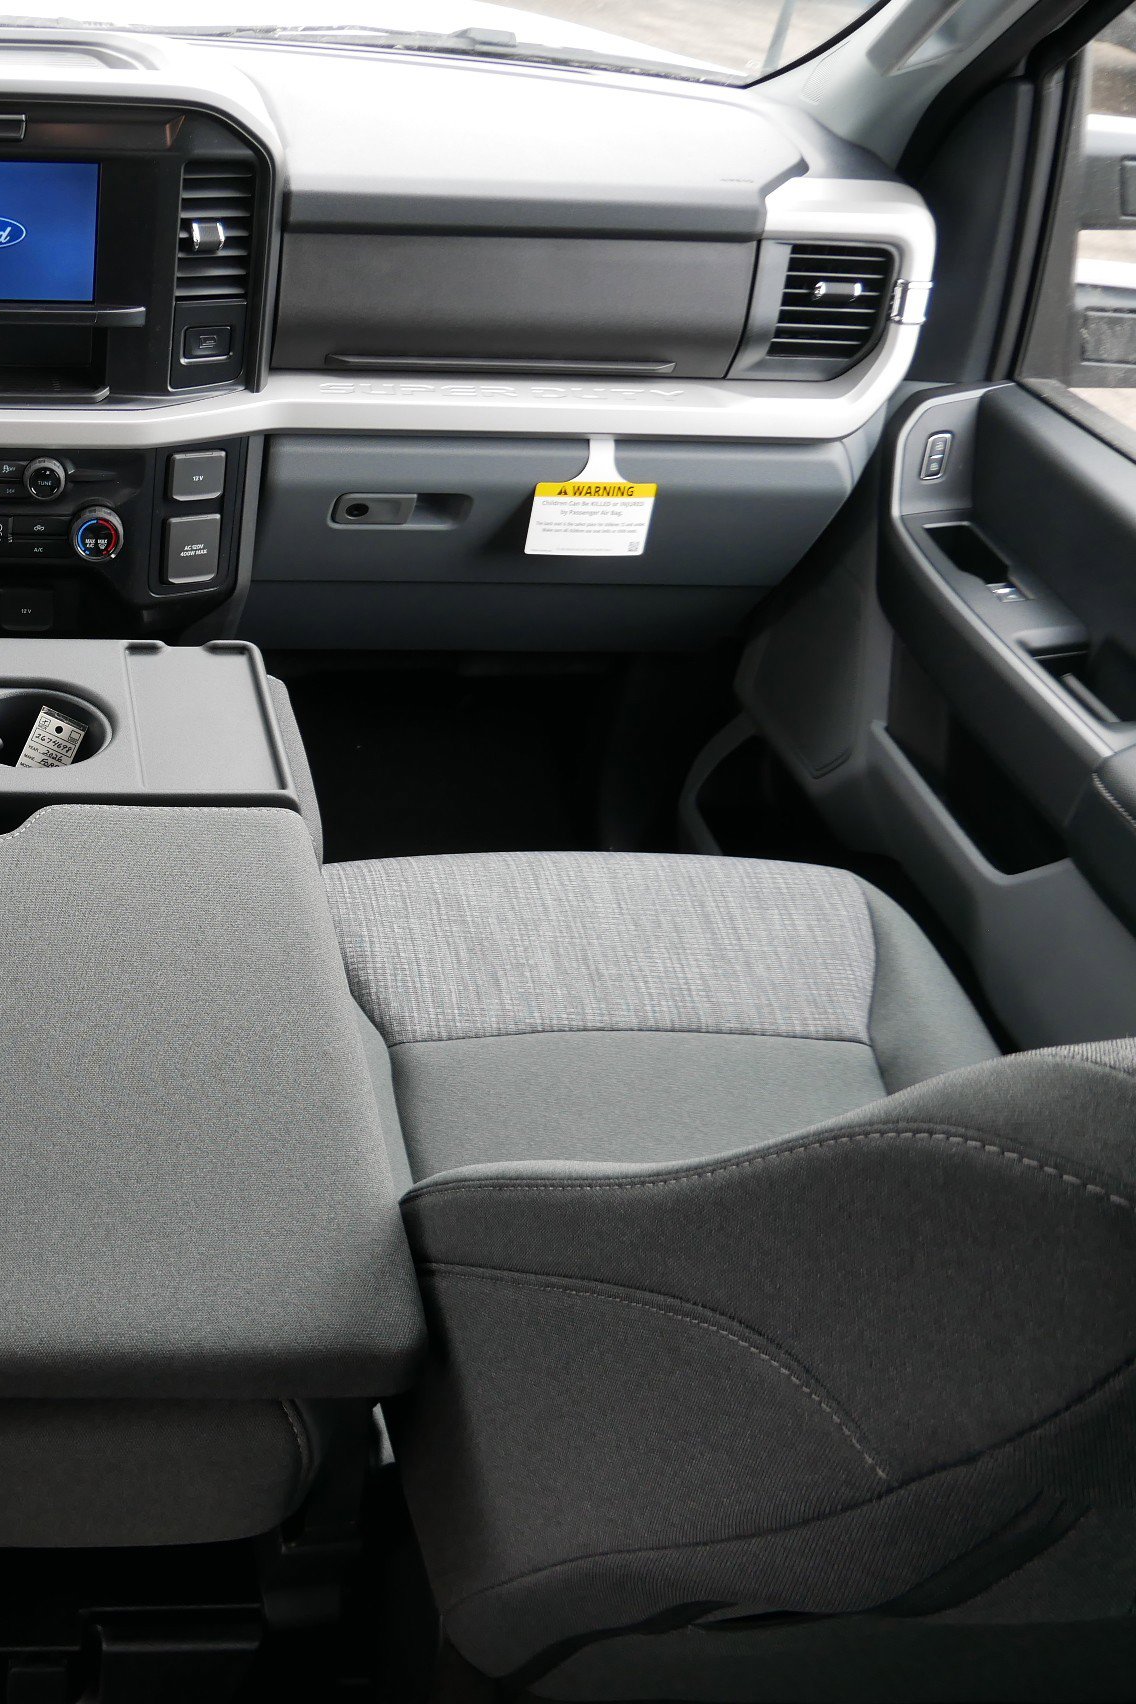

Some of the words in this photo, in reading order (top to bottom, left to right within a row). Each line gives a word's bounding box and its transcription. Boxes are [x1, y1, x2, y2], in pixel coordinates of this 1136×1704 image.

[319, 382, 519, 397] SUPER
[530, 386, 685, 401] DUTY
[572, 485, 635, 496] WARNING
[28, 745, 39, 753] YEAR
[43, 749, 63, 763] 2026
